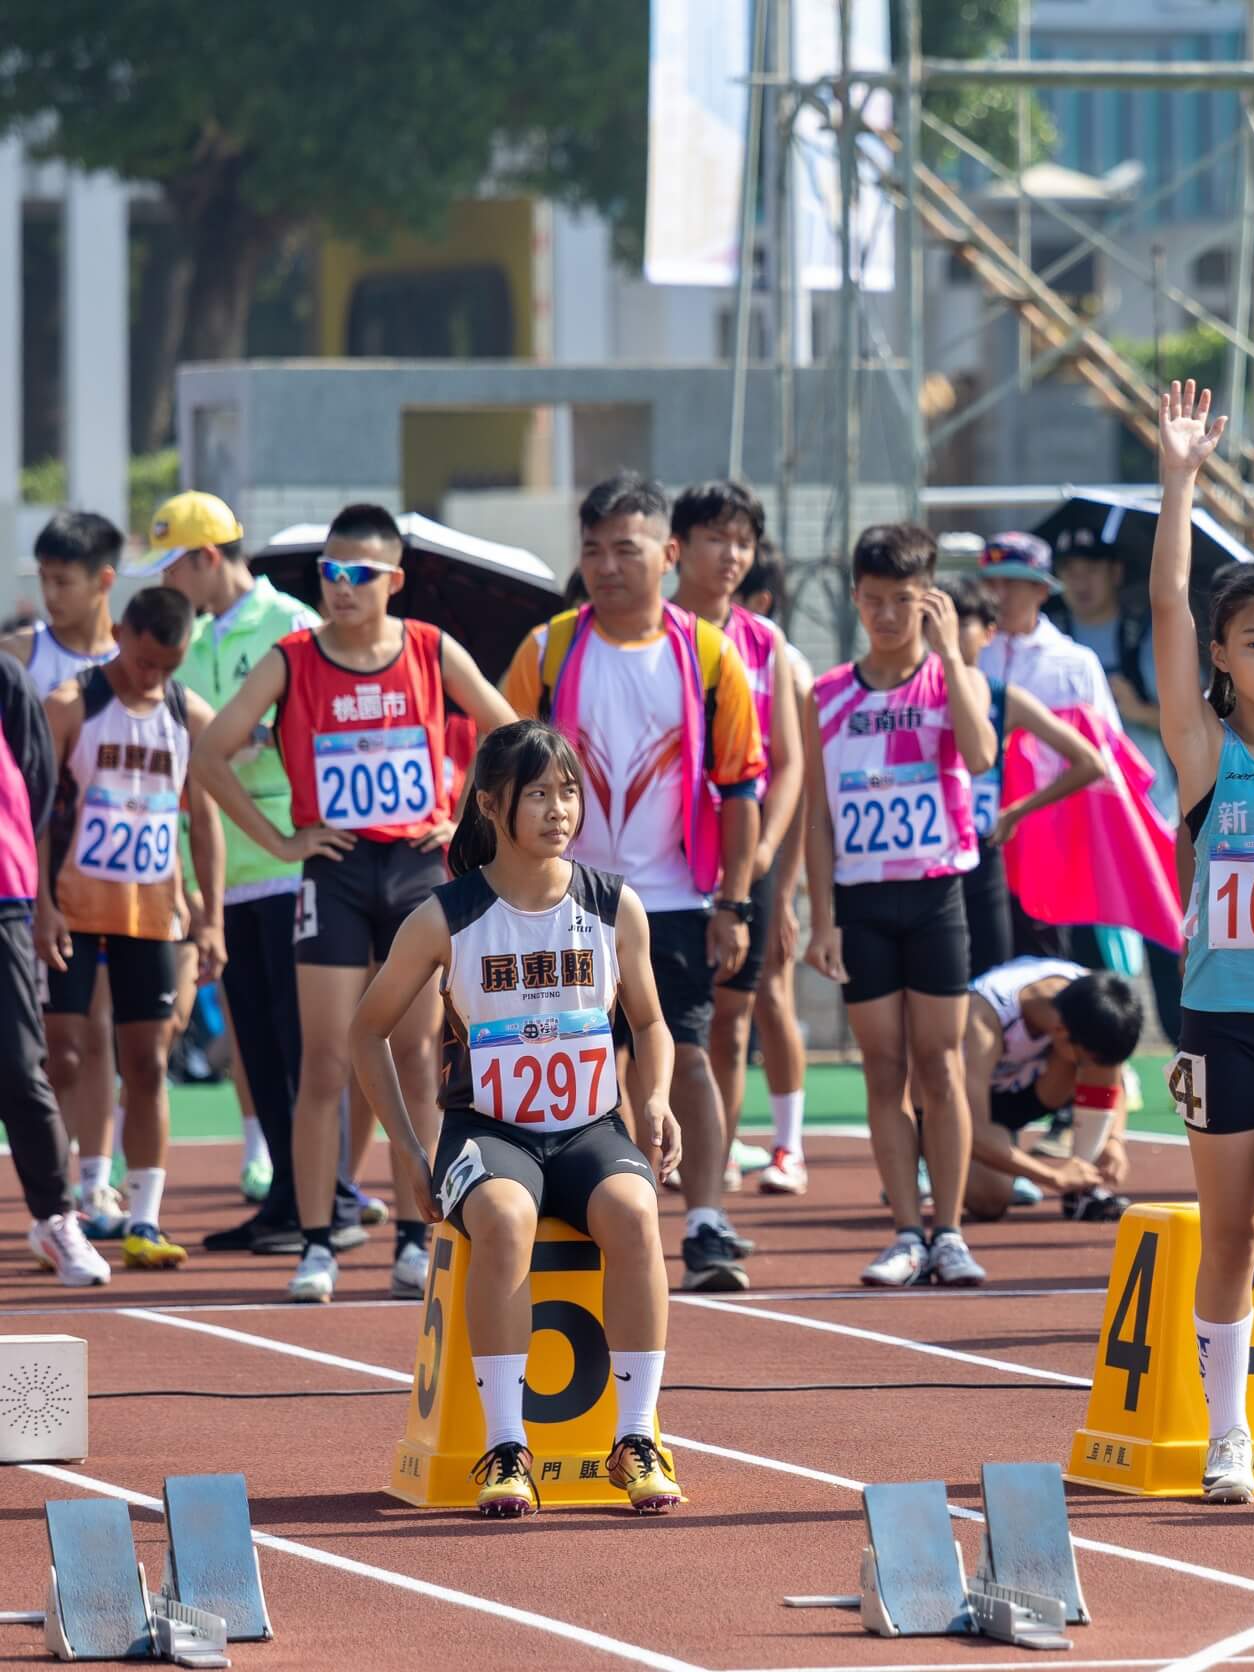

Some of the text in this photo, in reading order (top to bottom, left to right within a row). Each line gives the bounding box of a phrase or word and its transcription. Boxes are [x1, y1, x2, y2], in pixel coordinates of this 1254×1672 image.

[322, 760, 427, 819] 2093
[80, 817, 170, 873] 2269
[842, 793, 941, 854] 2232
[481, 949, 595, 993] 屏東縣
[481, 1048, 607, 1123] 1297
[1169, 1057, 1202, 1120] 4
[418, 1237, 453, 1419] 5
[1105, 1231, 1158, 1412] 4
